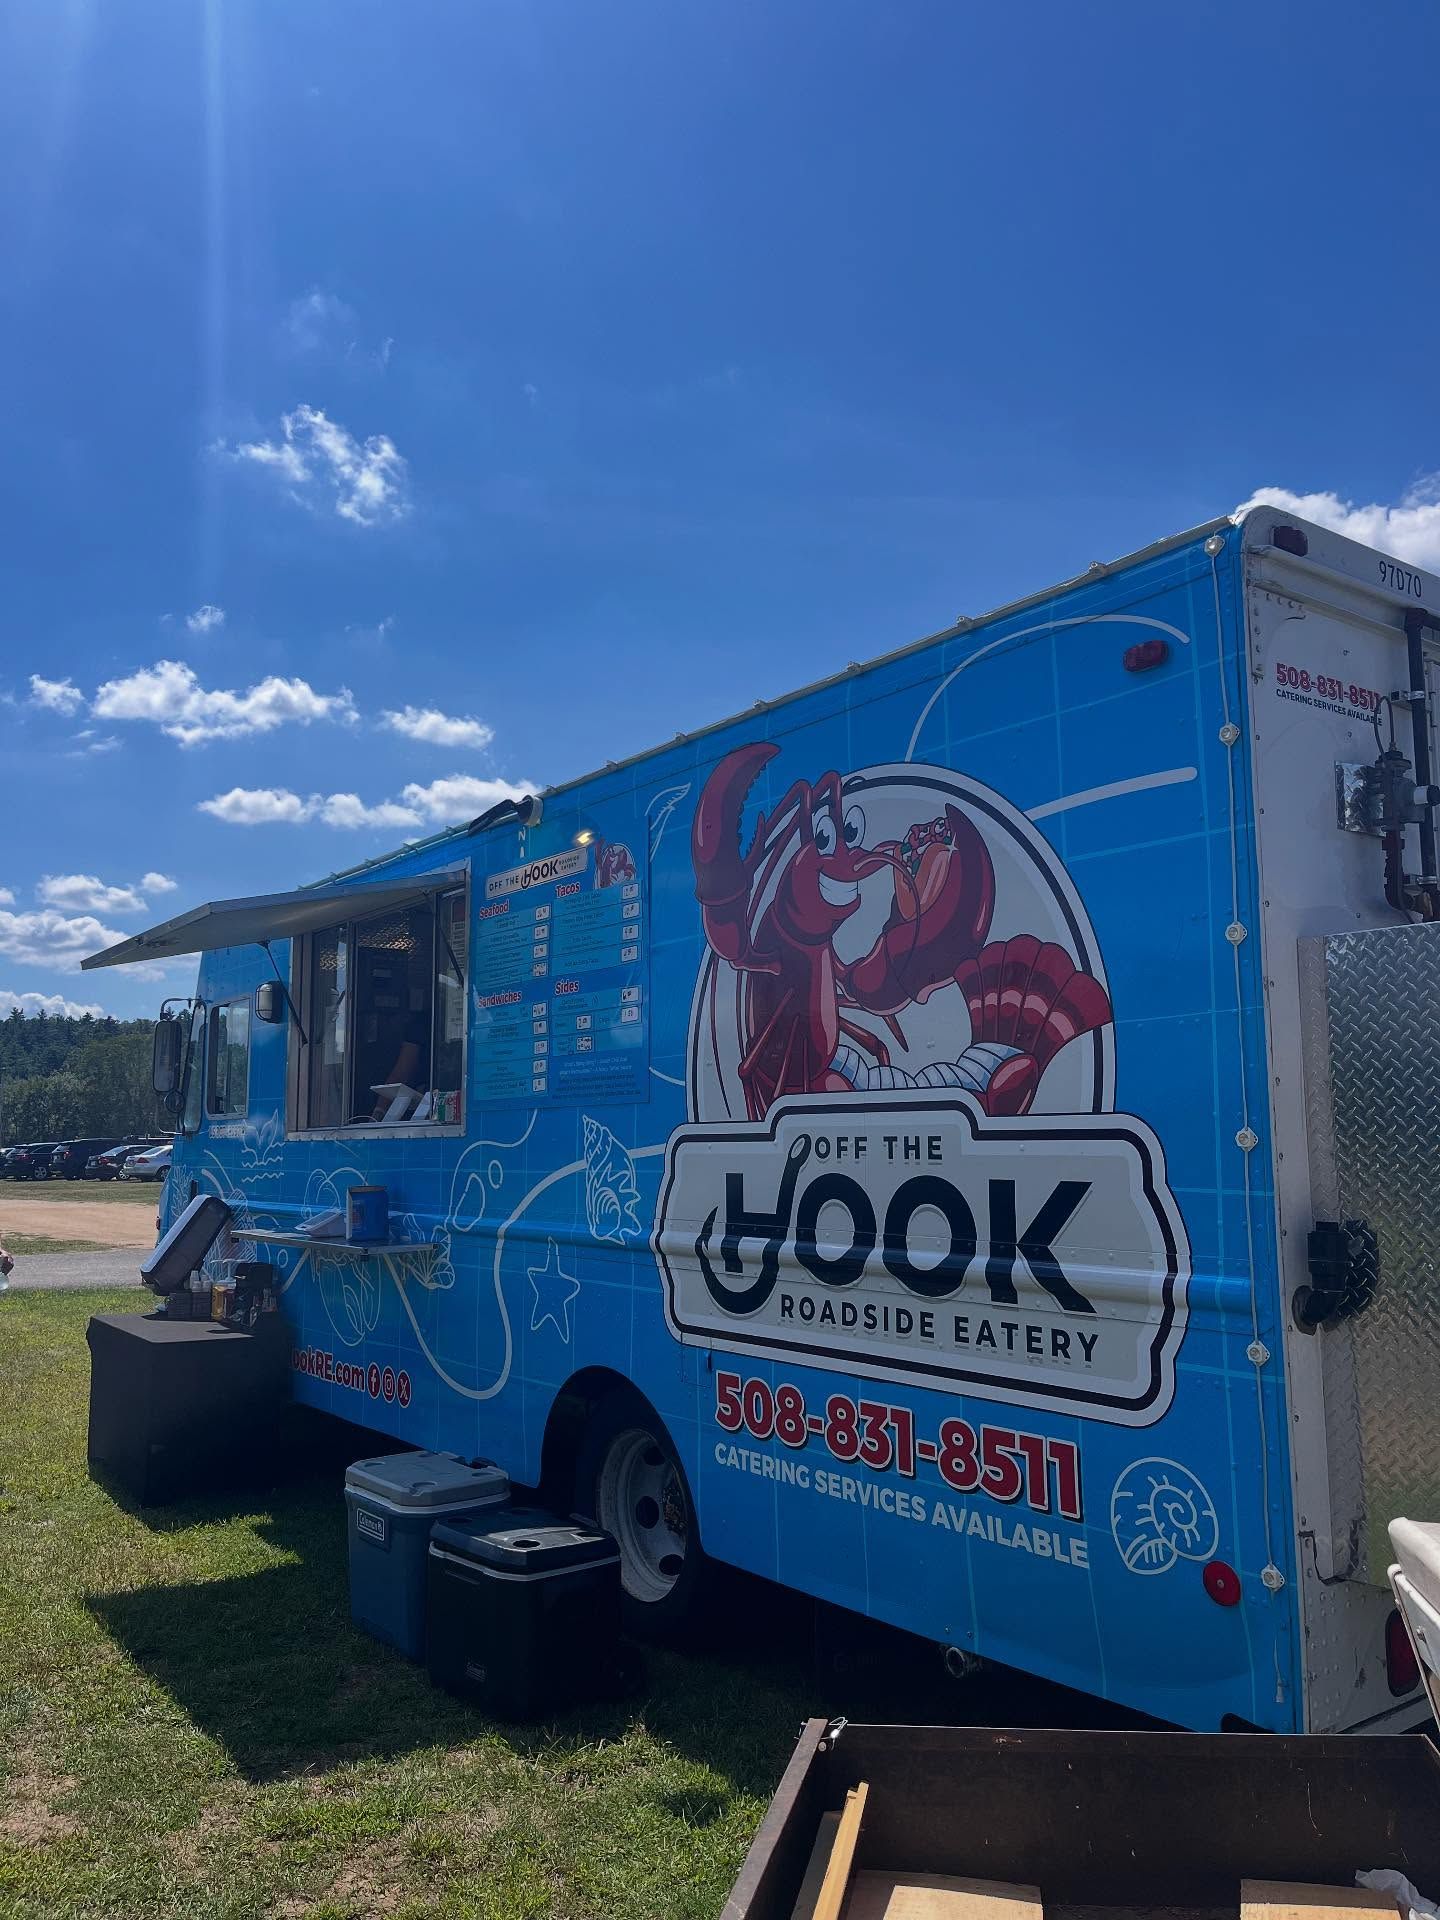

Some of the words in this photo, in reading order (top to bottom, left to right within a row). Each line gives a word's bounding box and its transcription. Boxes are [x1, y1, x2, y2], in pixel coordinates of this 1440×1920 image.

[1379, 560, 1422, 598] 97D70
[1276, 689, 1312, 706] CATERING
[1313, 698, 1346, 716] SERVICES
[1347, 709, 1383, 726] AVAILABE
[489, 880, 503, 892] OFF
[505, 875, 519, 887] THE
[520, 859, 559, 889] HOOK
[556, 882, 581, 898] Tacos
[479, 899, 510, 920] Seafood
[478, 989, 522, 1008] Sandwiches
[554, 978, 580, 995] Sides
[814, 1136, 868, 1160] OFF
[883, 1135, 943, 1161] THE
[695, 1133, 1098, 1315] HOOK
[780, 1293, 936, 1339] ROADSIDE
[953, 1315, 1100, 1362] EATERY
[715, 1371, 1083, 1522] 508-831-8511
[714, 1443, 810, 1489] CATERING
[815, 1471, 925, 1522] SERVICES
[931, 1501, 1090, 1569] AVAILABLE
